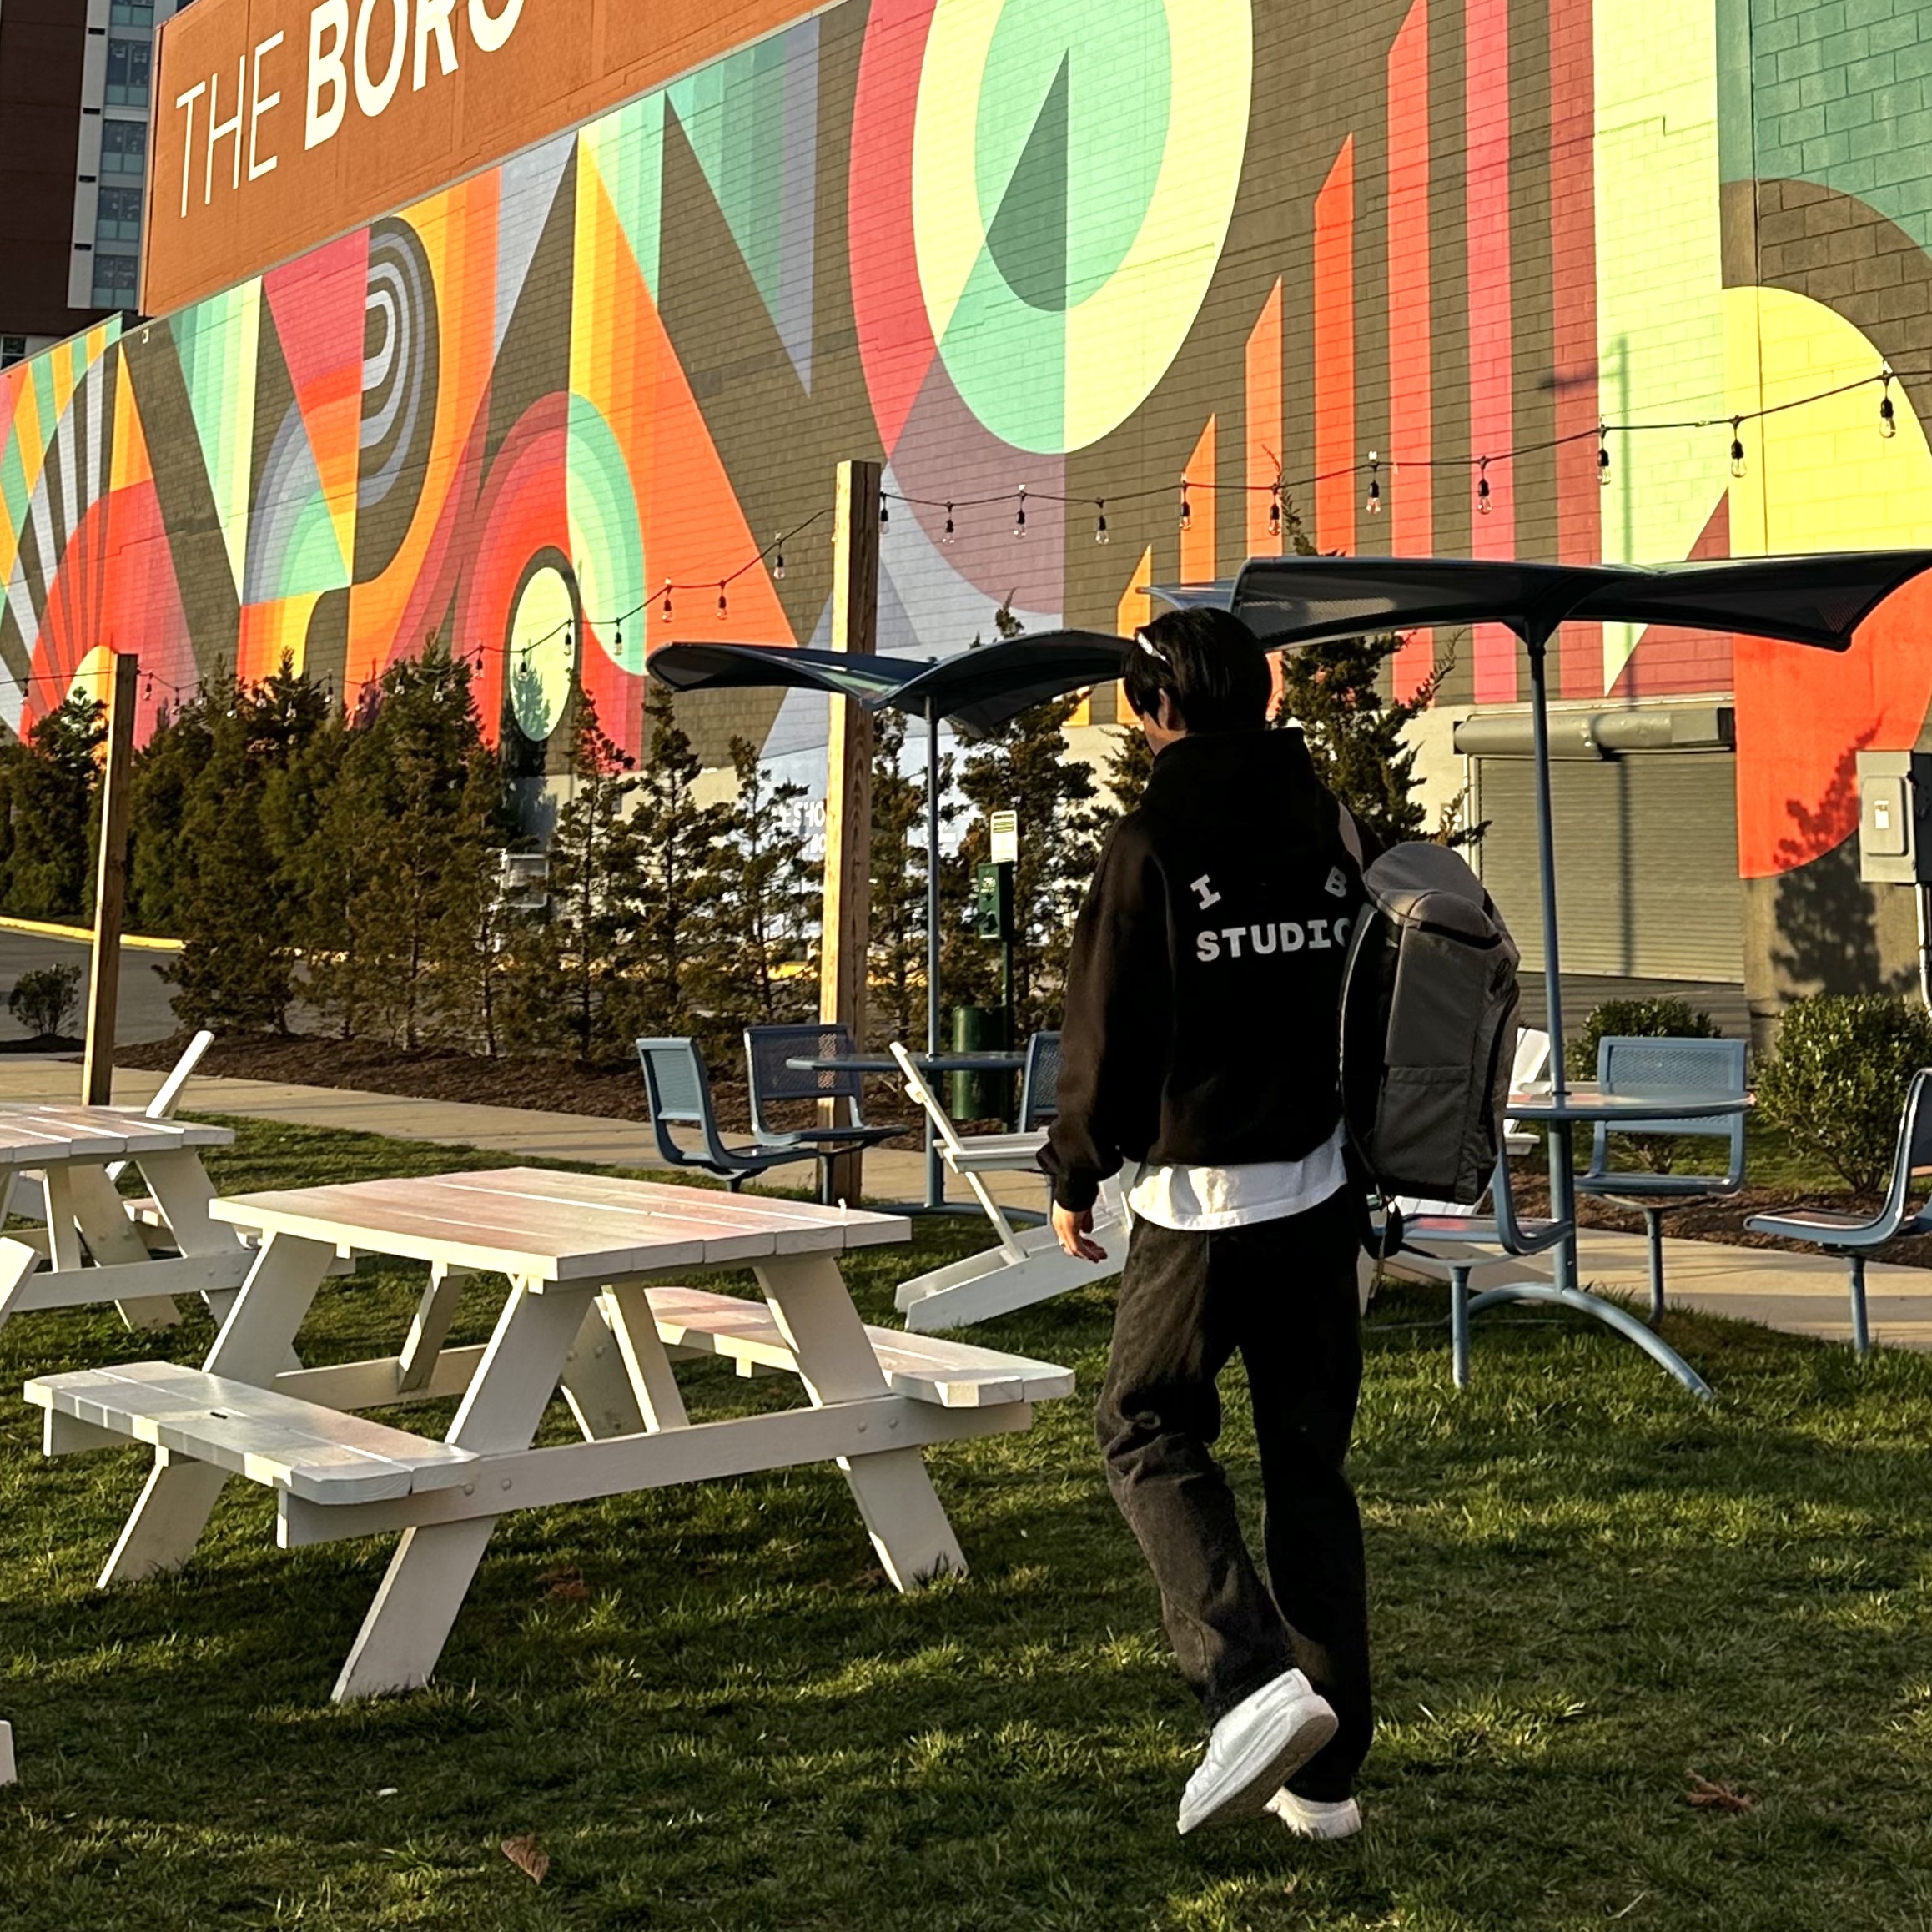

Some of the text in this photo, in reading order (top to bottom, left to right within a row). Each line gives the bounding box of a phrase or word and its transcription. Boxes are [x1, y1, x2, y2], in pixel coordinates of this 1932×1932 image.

[176, 30, 284, 218] THE
[1190, 865, 1347, 910] I B
